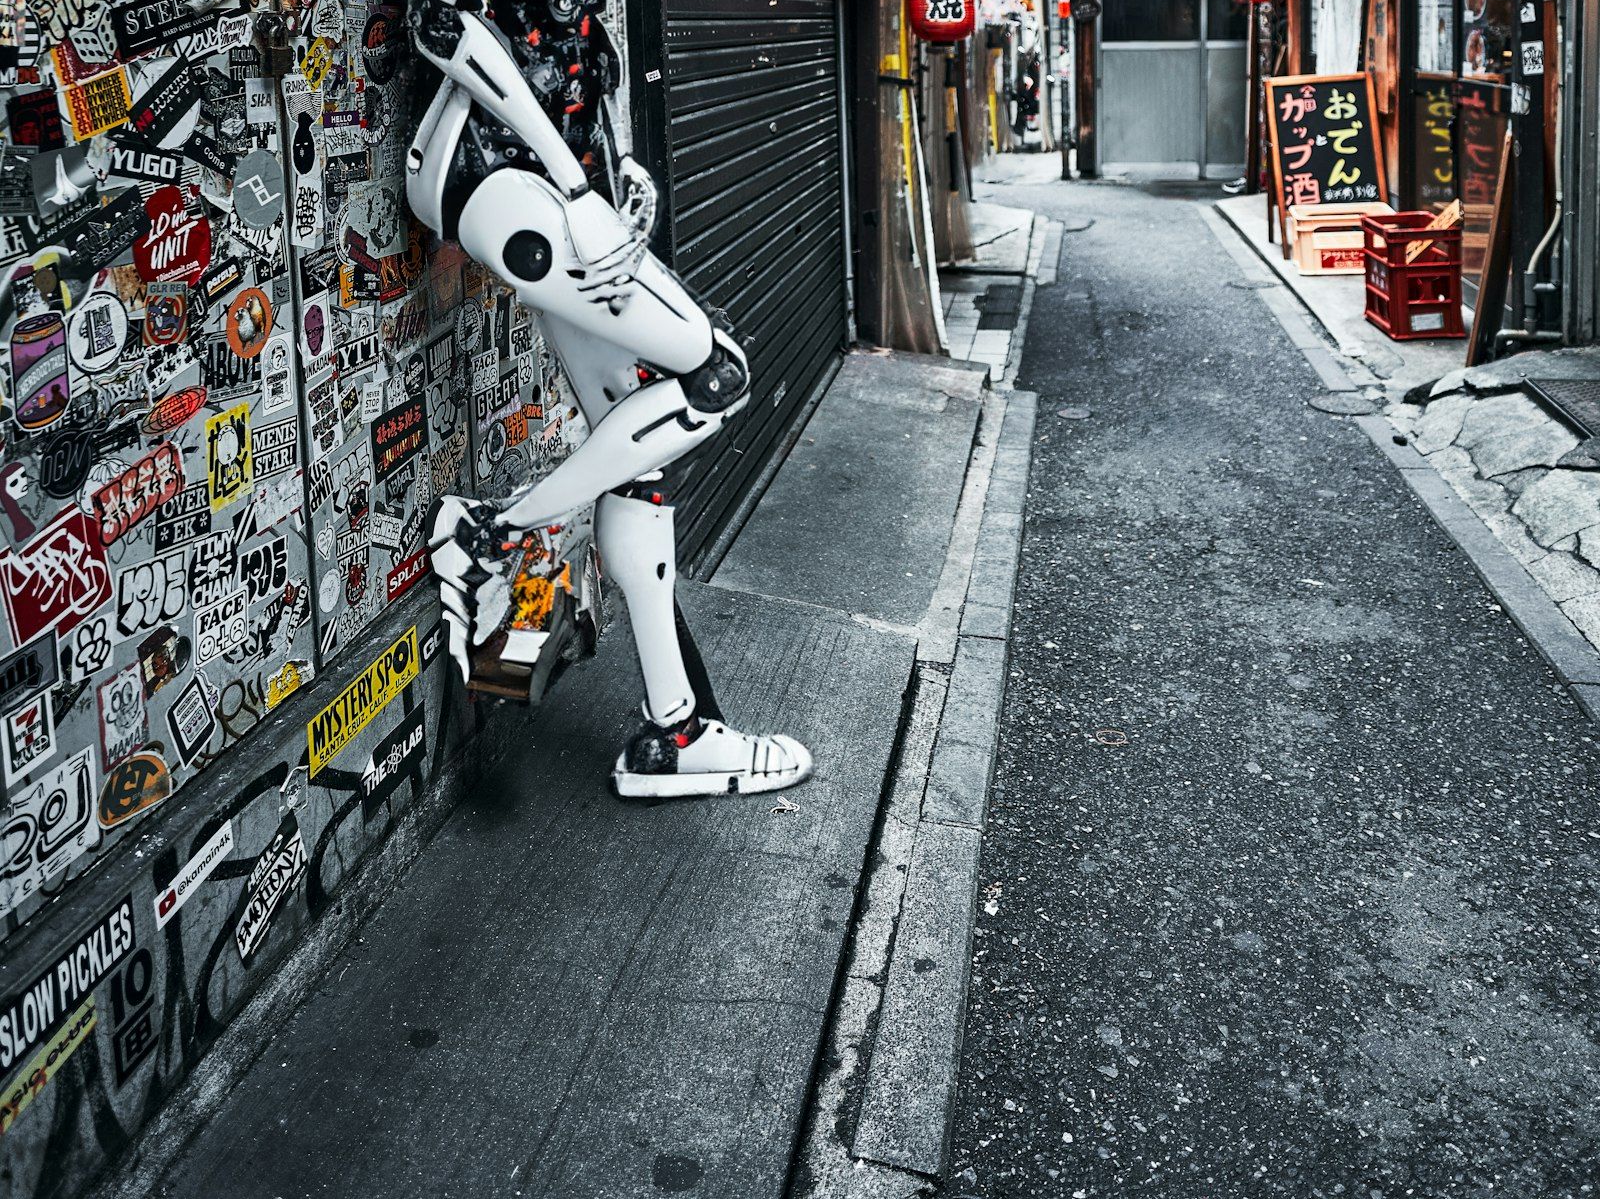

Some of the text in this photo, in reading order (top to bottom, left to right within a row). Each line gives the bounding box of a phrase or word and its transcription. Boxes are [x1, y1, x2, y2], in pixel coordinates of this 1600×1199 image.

[331, 114, 353, 125] HELLO
[1279, 92, 1322, 206] カップ酒
[1323, 87, 1363, 188] おでん
[112, 147, 177, 179] YUGO
[203, 147, 226, 170] come
[151, 220, 199, 270] UNIT
[150, 284, 167, 293] GLR
[473, 352, 497, 373] FACE
[365, 400, 380, 409] STOP
[477, 372, 518, 418] GREAT
[252, 421, 297, 453] MENIS
[255, 446, 295, 478] STAR!
[162, 486, 207, 519] OVER
[336, 525, 369, 557] MENIS
[389, 553, 427, 594] SPLAT
[192, 575, 233, 609] CHAN
[199, 594, 244, 636] FACE
[312, 630, 415, 757] MYSTERY SPOT
[319, 669, 413, 763] SANTA CRUZ, CALIF. U.S.A.
[363, 723, 423, 797] THE LAB
[0, 972, 55, 1068] SLOW
[57, 902, 132, 1012] PICKLES
